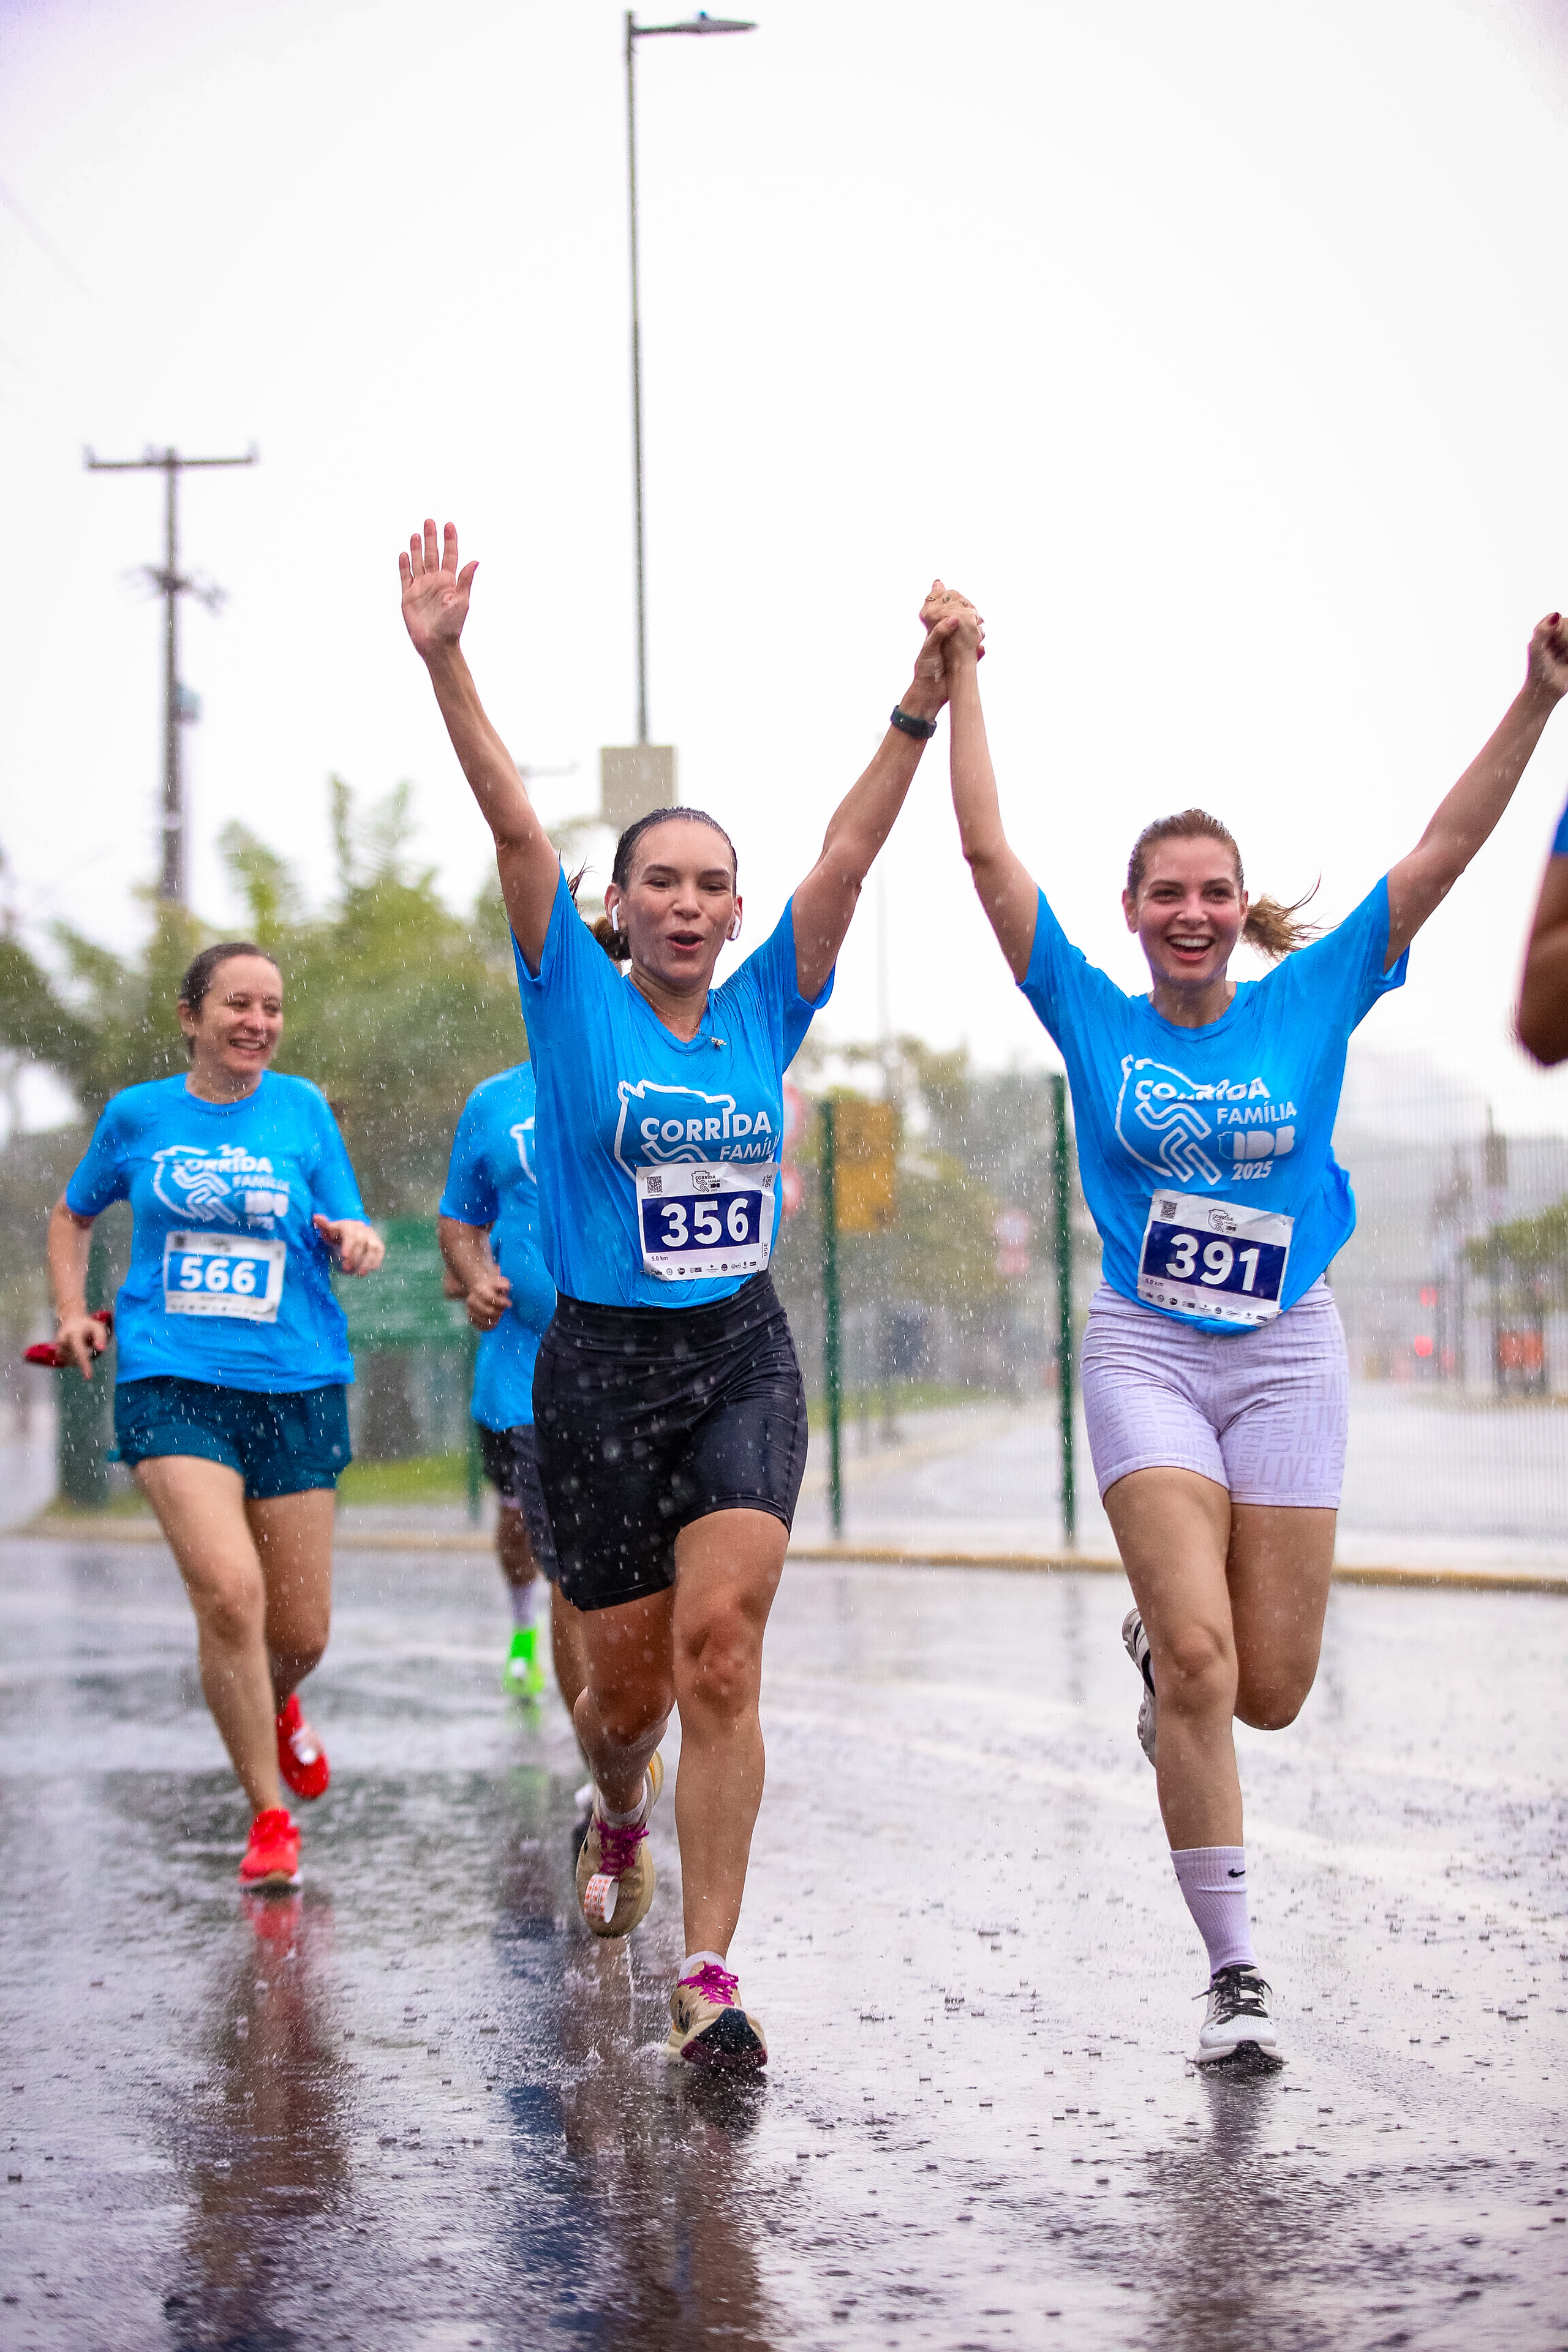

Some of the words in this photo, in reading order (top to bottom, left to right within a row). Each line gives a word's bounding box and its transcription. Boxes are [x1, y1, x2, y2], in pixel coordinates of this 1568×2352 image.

[641, 1110, 772, 1142] CORRIDA
[1217, 1101, 1297, 1125] FAMÍLIA
[1231, 1161, 1273, 1180] 2025
[660, 1198, 748, 1247] 356
[179, 1256, 256, 1294] 566
[1166, 1234, 1261, 1292] 391
